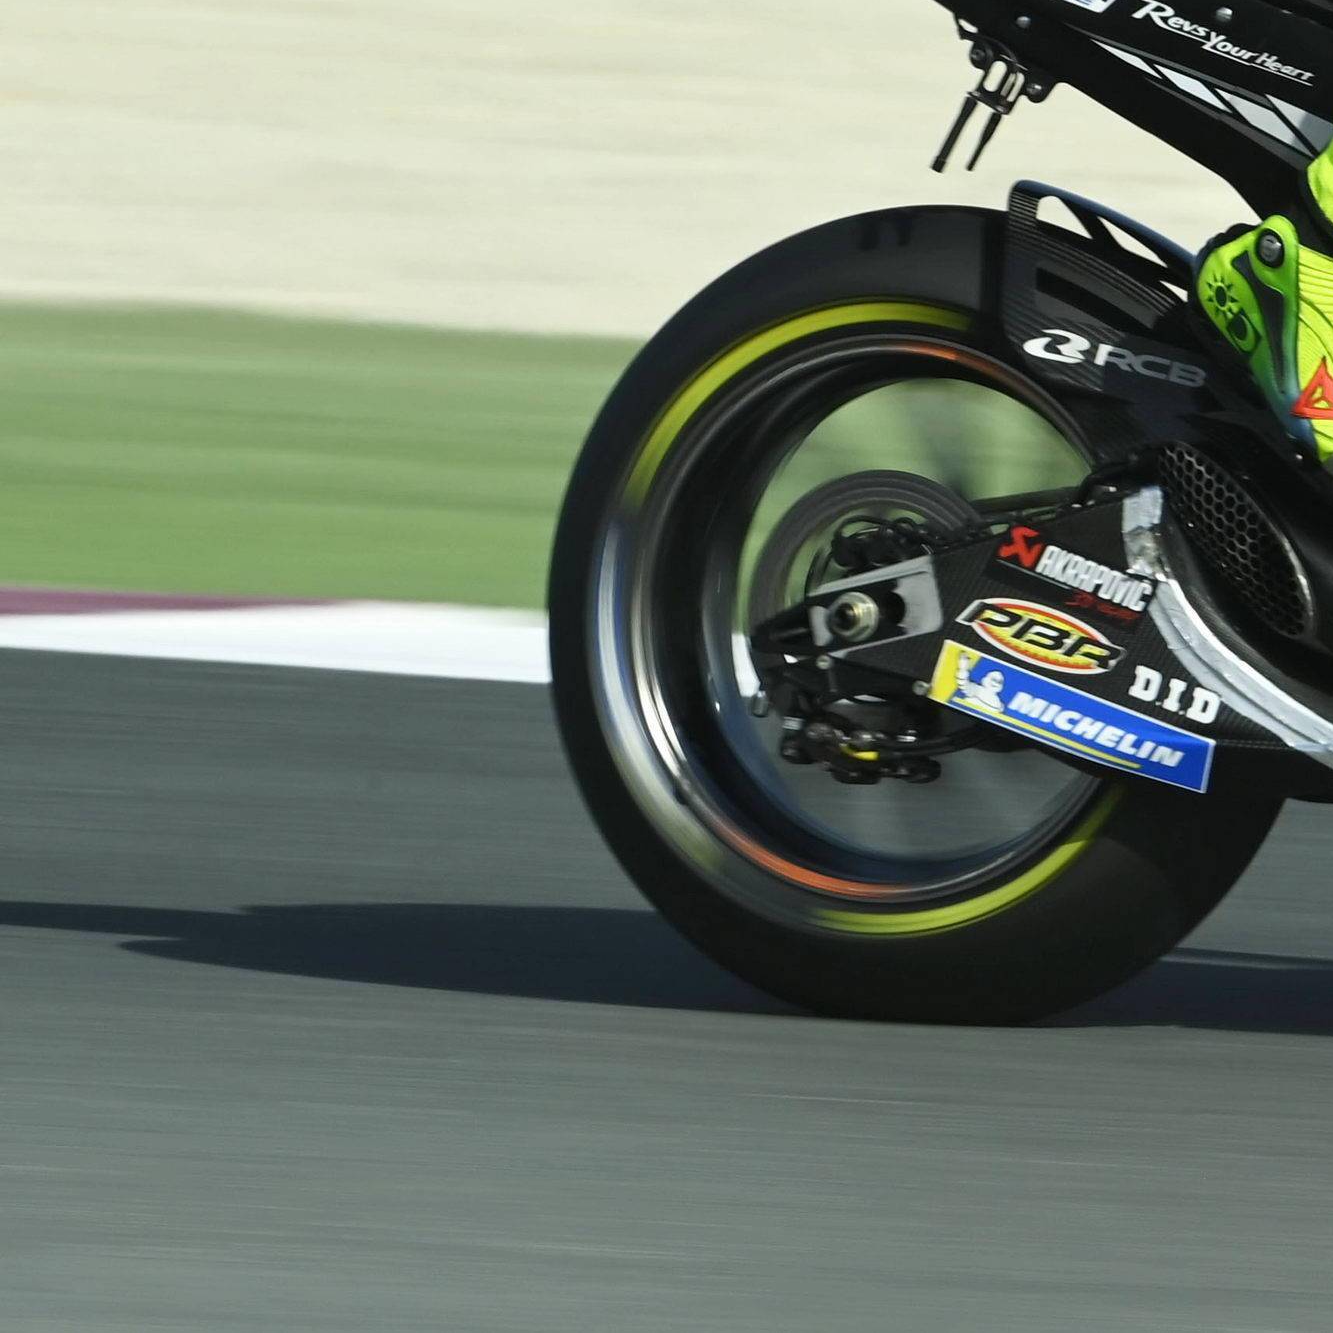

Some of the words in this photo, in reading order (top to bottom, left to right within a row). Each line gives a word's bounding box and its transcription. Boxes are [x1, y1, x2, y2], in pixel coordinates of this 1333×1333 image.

[1094, 342, 1206, 388] RCB
[963, 599, 1122, 671] PBR
[1128, 665, 1221, 724] D.I.D
[1008, 691, 1186, 767] MICHELIN
